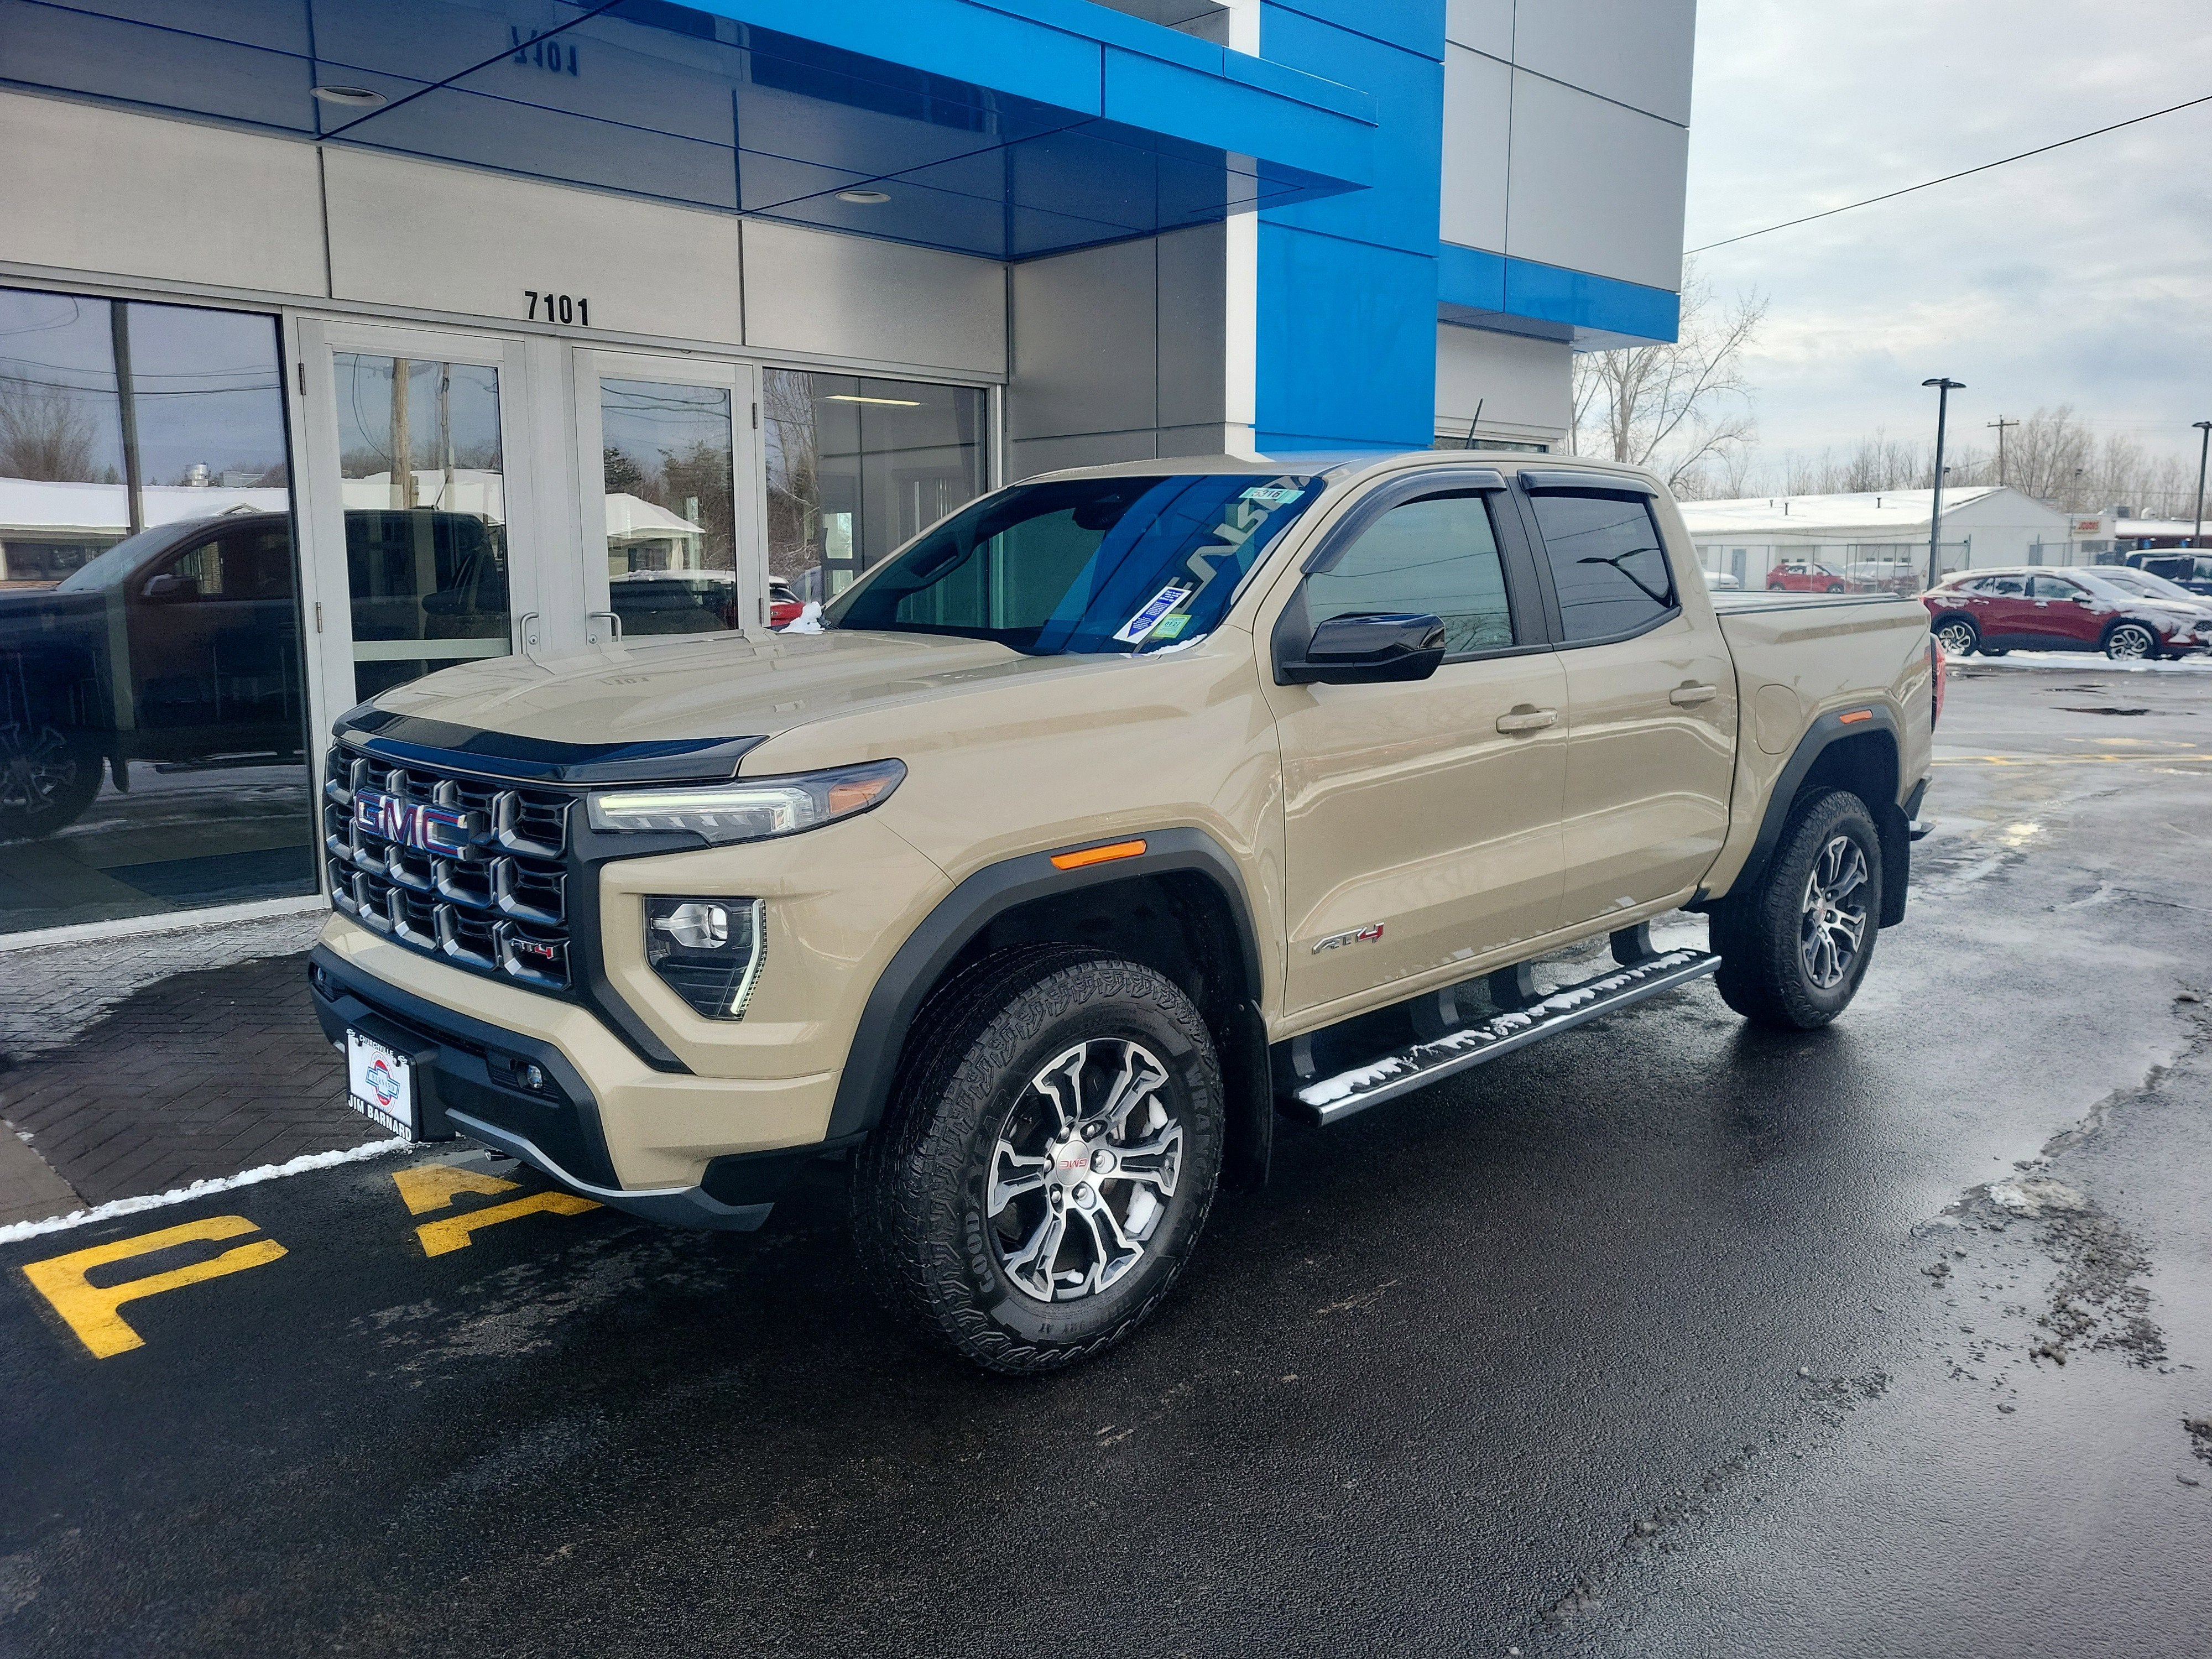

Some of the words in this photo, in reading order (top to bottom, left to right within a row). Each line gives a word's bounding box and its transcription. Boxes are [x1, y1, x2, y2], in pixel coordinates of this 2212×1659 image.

[525, 290, 588, 326] 7101
[354, 787, 469, 861] GMC
[1311, 922, 1385, 956] AT4
[359, 1034, 394, 1058] CHURCHVILLE
[348, 1094, 364, 1114] JIM
[367, 1104, 412, 1142] BARNARD
[1059, 1157, 1088, 1170] GMC
